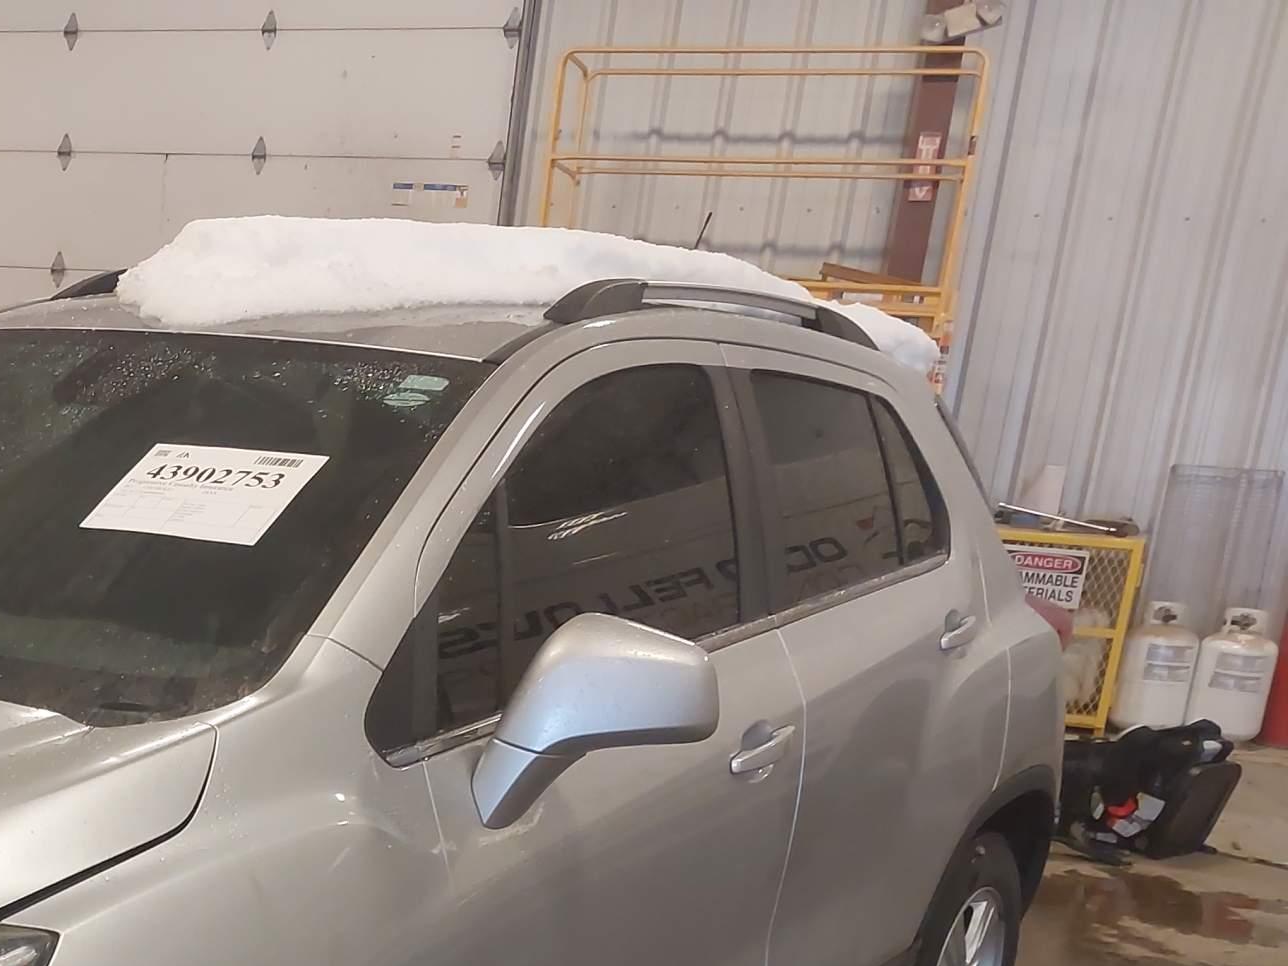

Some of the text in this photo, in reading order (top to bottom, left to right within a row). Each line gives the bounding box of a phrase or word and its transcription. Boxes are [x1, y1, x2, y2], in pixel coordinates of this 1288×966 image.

[146, 463, 286, 489] 43902753
[1015, 555, 1073, 570] DANGER
[1024, 585, 1074, 603] ERIALS
